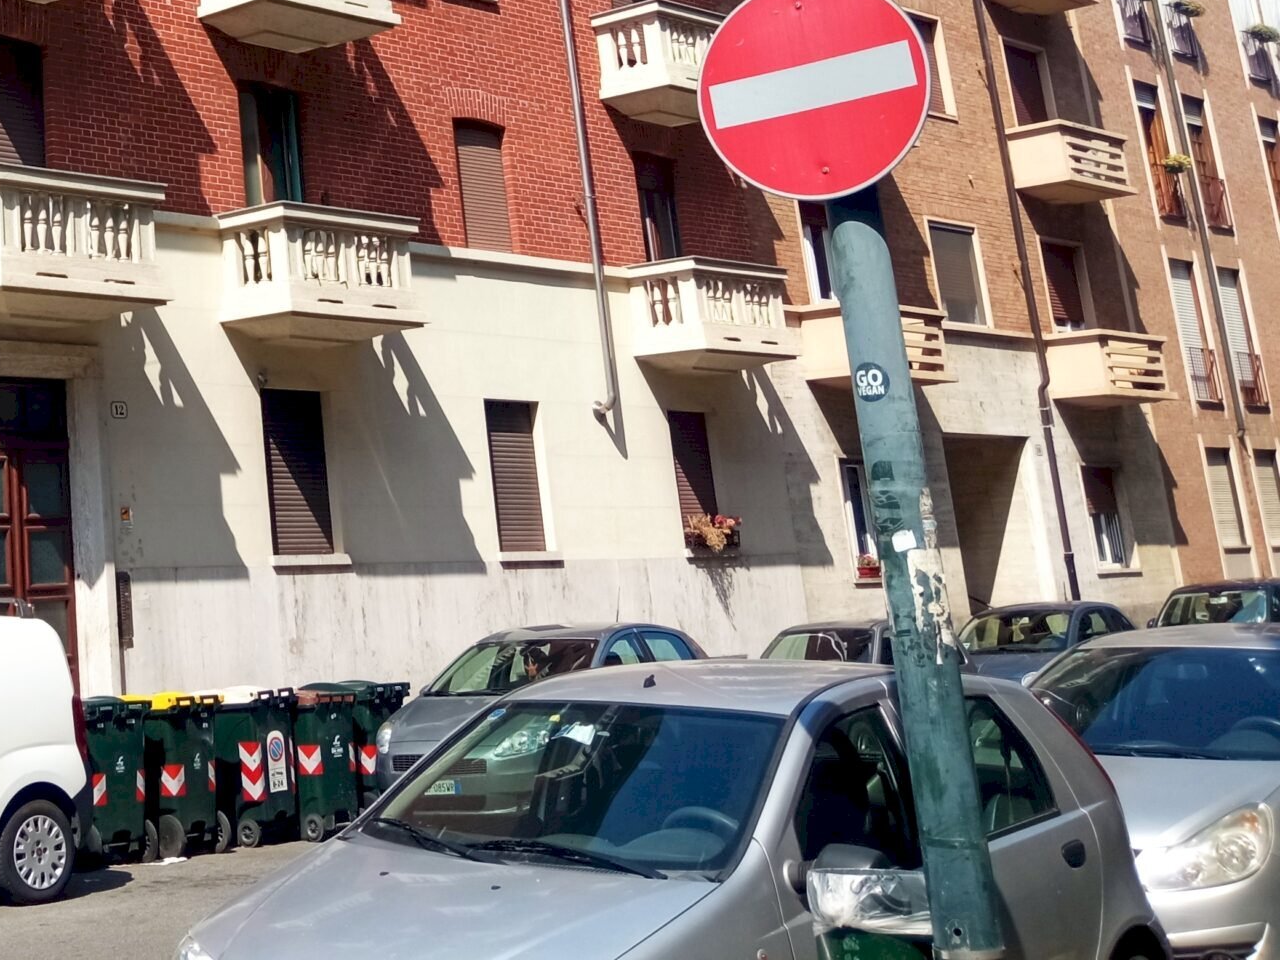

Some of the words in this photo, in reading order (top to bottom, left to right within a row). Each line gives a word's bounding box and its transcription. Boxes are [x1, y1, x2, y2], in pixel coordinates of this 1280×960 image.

[856, 368, 883, 387] GO
[858, 385, 885, 396] VEGAN
[114, 404, 125, 416] 12
